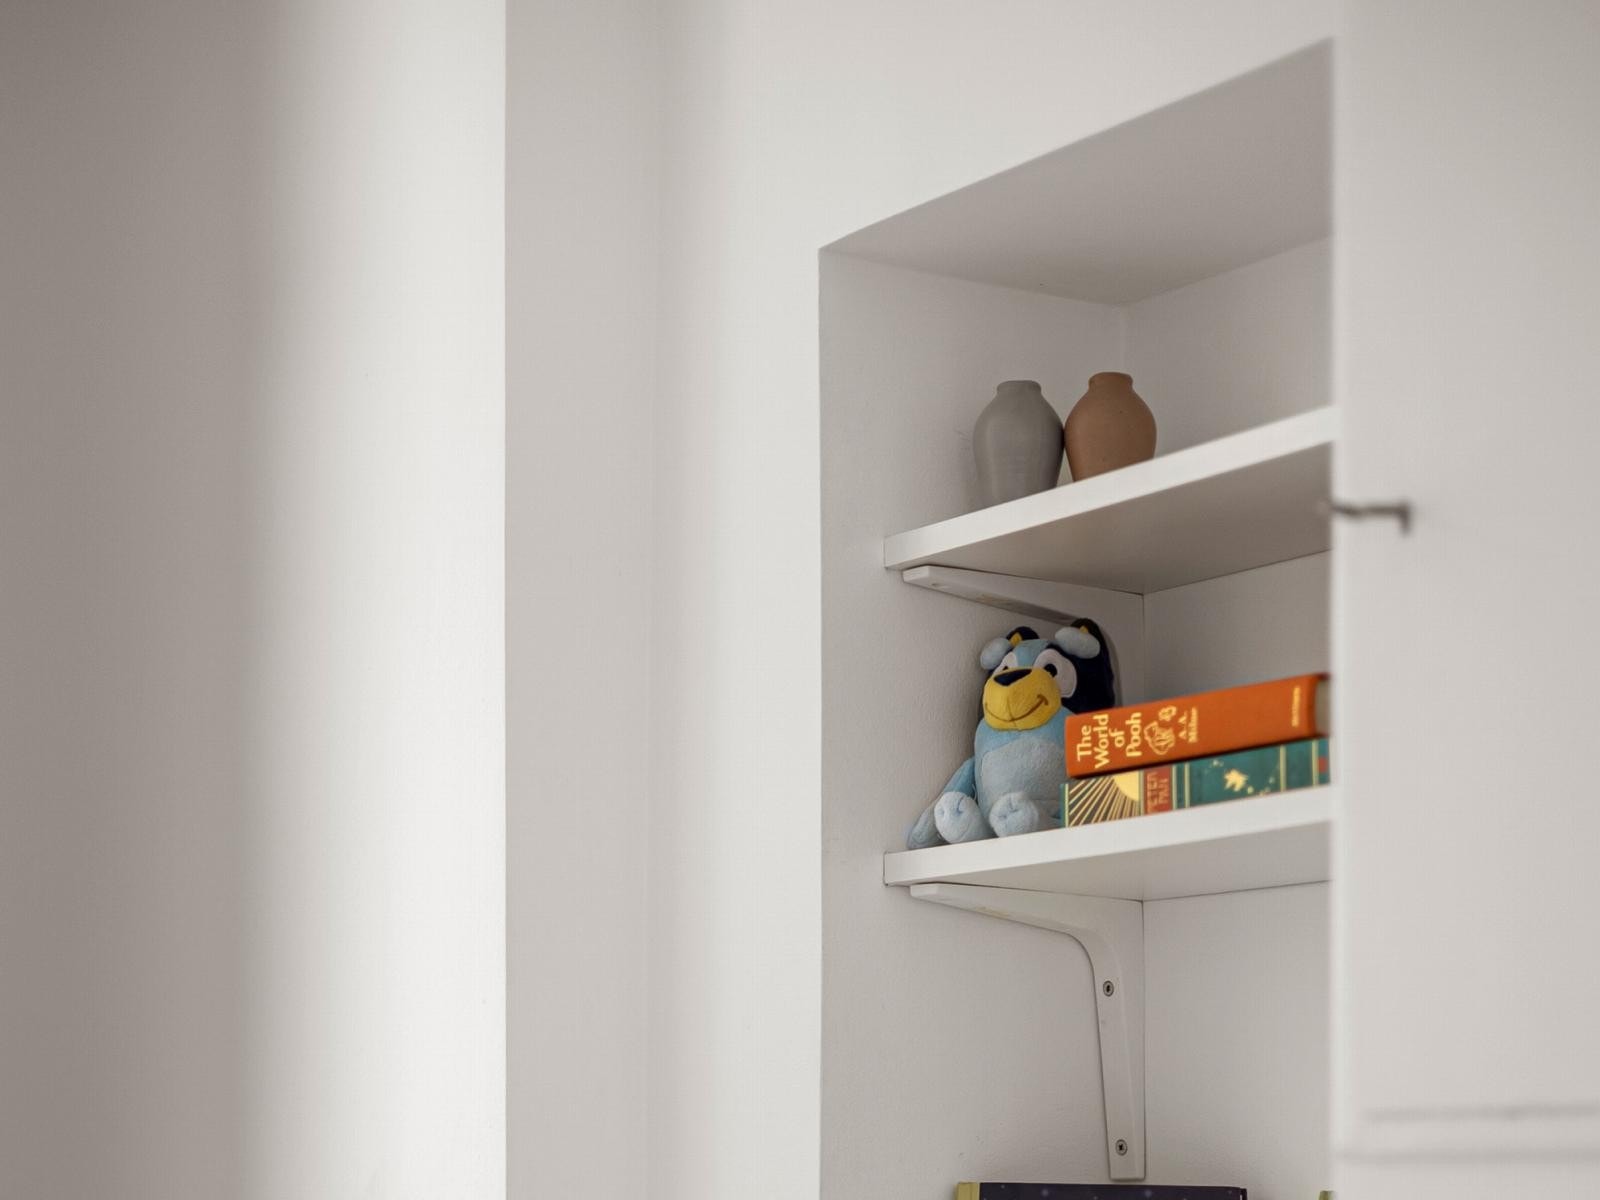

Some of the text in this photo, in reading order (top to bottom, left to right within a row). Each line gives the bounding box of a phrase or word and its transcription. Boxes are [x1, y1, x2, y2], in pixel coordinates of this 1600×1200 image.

[1076, 725, 1092, 762] The
[1093, 713, 1110, 769] World
[1108, 727, 1125, 748] of
[1125, 711, 1142, 757] Pooh
